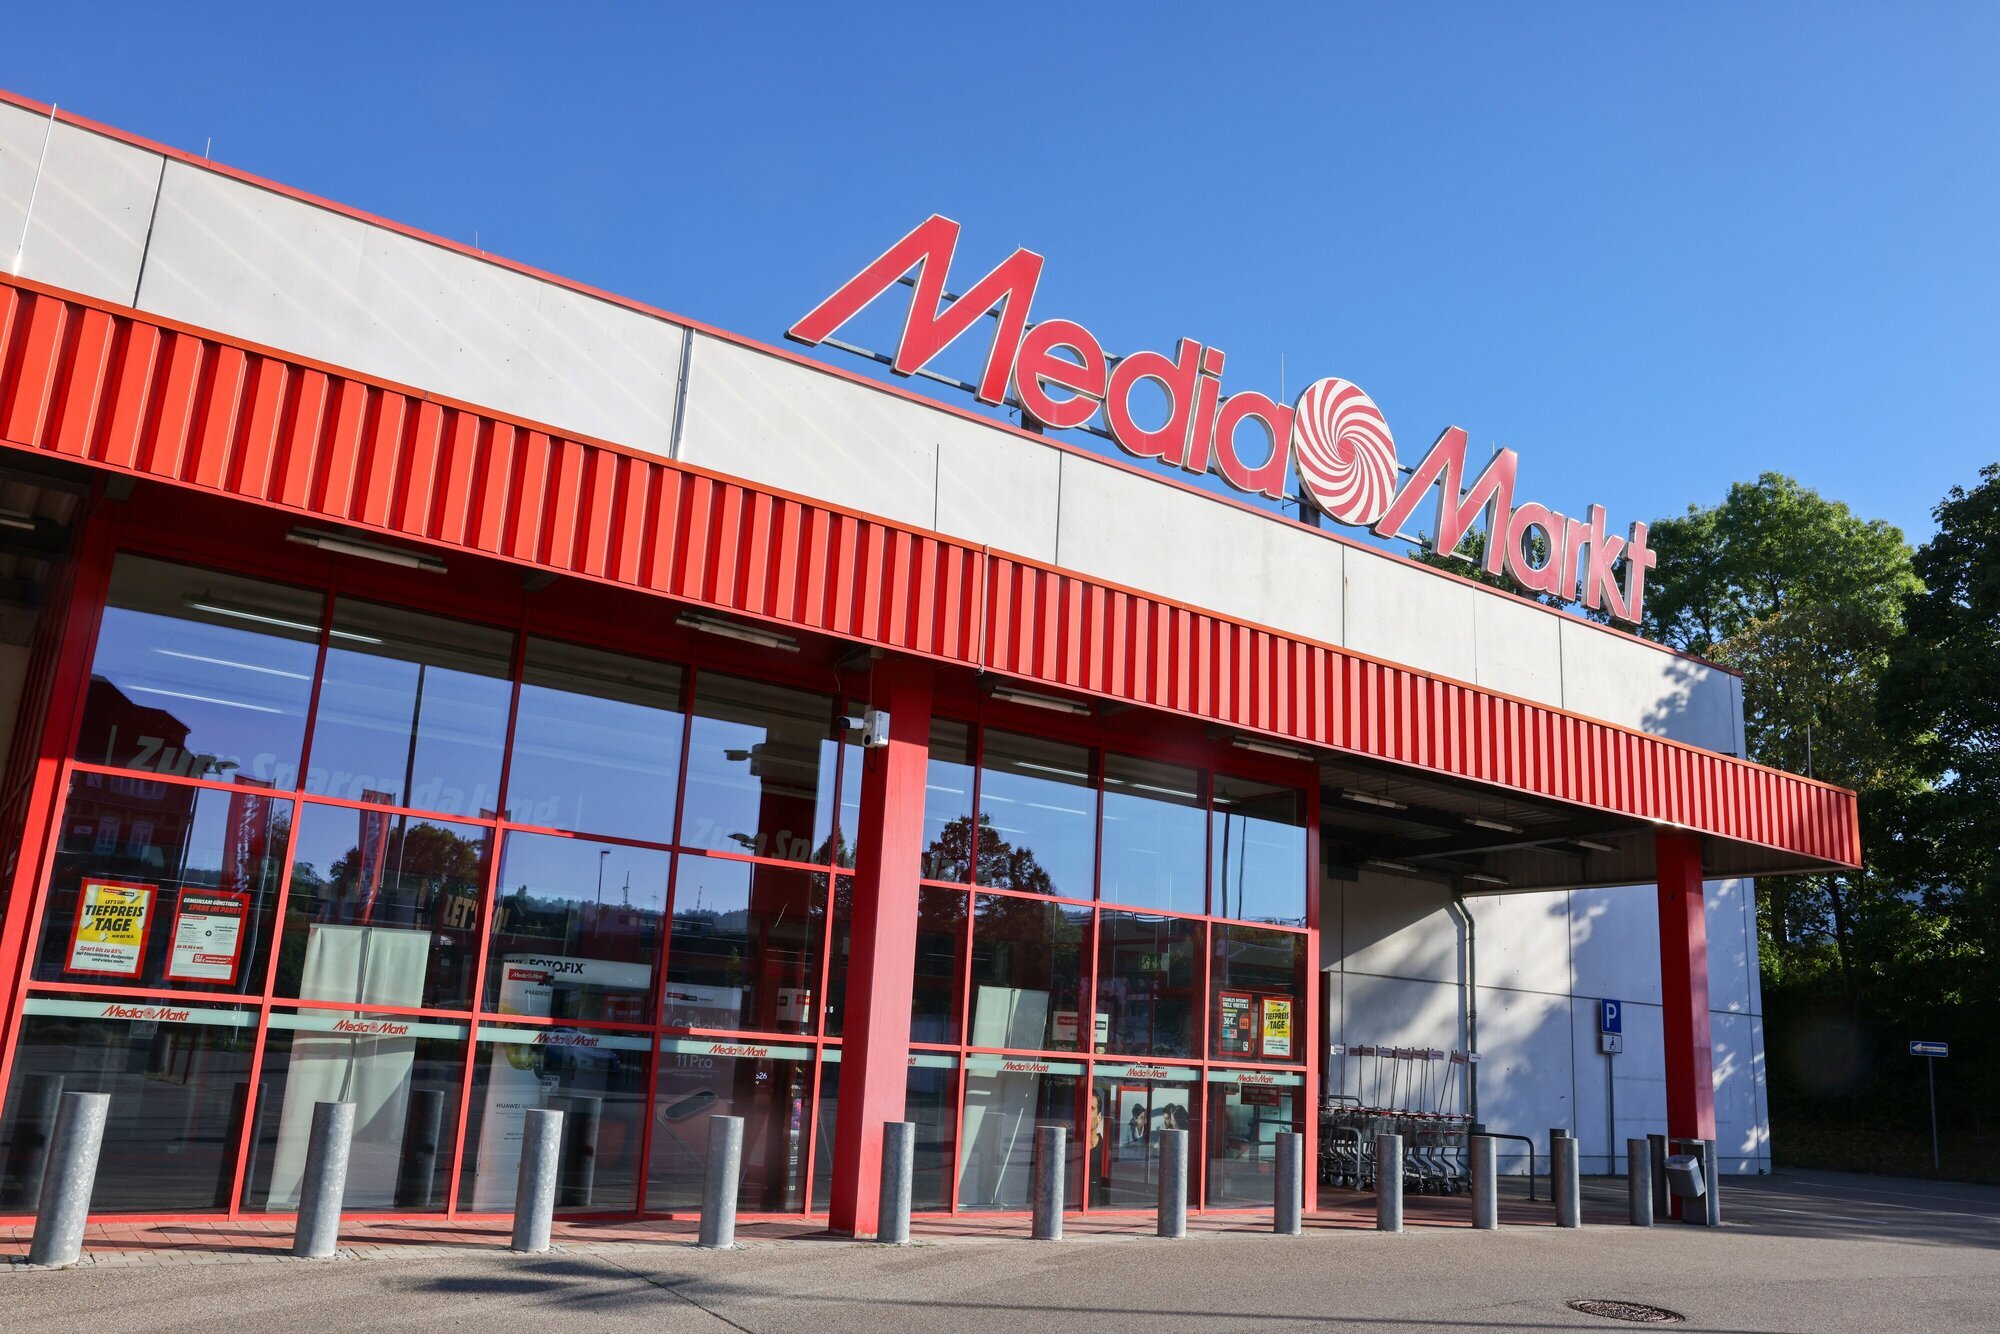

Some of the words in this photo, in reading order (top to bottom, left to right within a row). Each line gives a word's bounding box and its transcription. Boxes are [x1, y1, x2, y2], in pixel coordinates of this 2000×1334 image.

[786, 213, 1295, 499] Media
[1371, 425, 1656, 625] Markt
[85, 905, 145, 917] TIEFPREIS
[95, 917, 133, 931] TAGE
[101, 1004, 144, 1019] Media
[152, 1008, 190, 1021] Markt
[1265, 1012, 1289, 1020] TIEFPREIS
[1606, 1003, 1617, 1028] P
[332, 1020, 370, 1032] Media
[377, 1023, 408, 1035] Markt
[1270, 1020, 1285, 1029] TAGE
[709, 1044, 737, 1055] Media
[742, 1046, 768, 1057] Markt
[676, 1054, 687, 1067] 11
[690, 1055, 713, 1069] Pro
